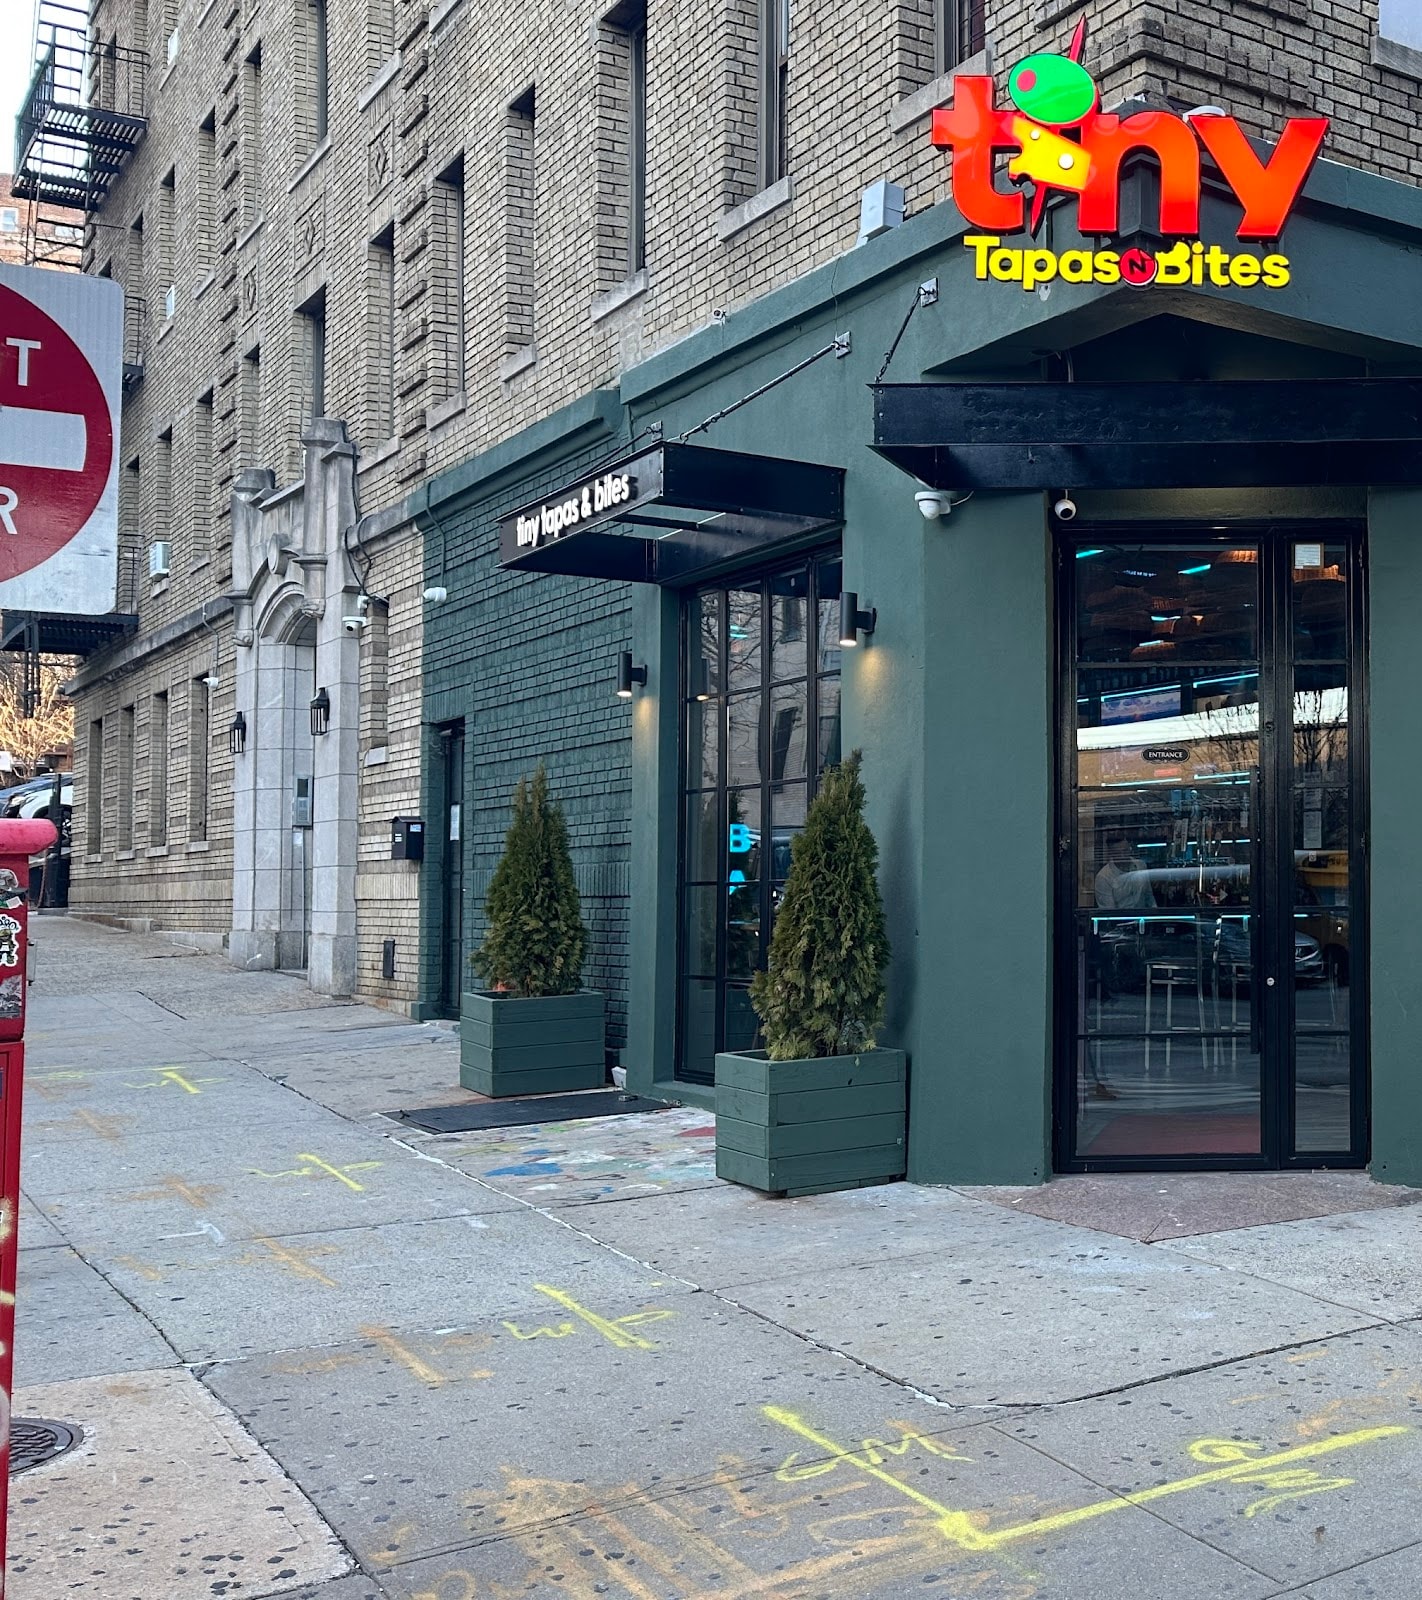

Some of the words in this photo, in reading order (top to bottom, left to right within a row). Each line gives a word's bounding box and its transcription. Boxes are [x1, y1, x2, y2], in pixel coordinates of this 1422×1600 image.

[931, 50, 1330, 242] tiny
[963, 235, 1121, 291] Tapas
[1154, 240, 1291, 287] Bites
[517, 515, 540, 547] tiny
[541, 498, 579, 538] tapas
[581, 487, 592, 518] &
[594, 474, 629, 512] bites
[1148, 750, 1183, 759] ENTRANCE
